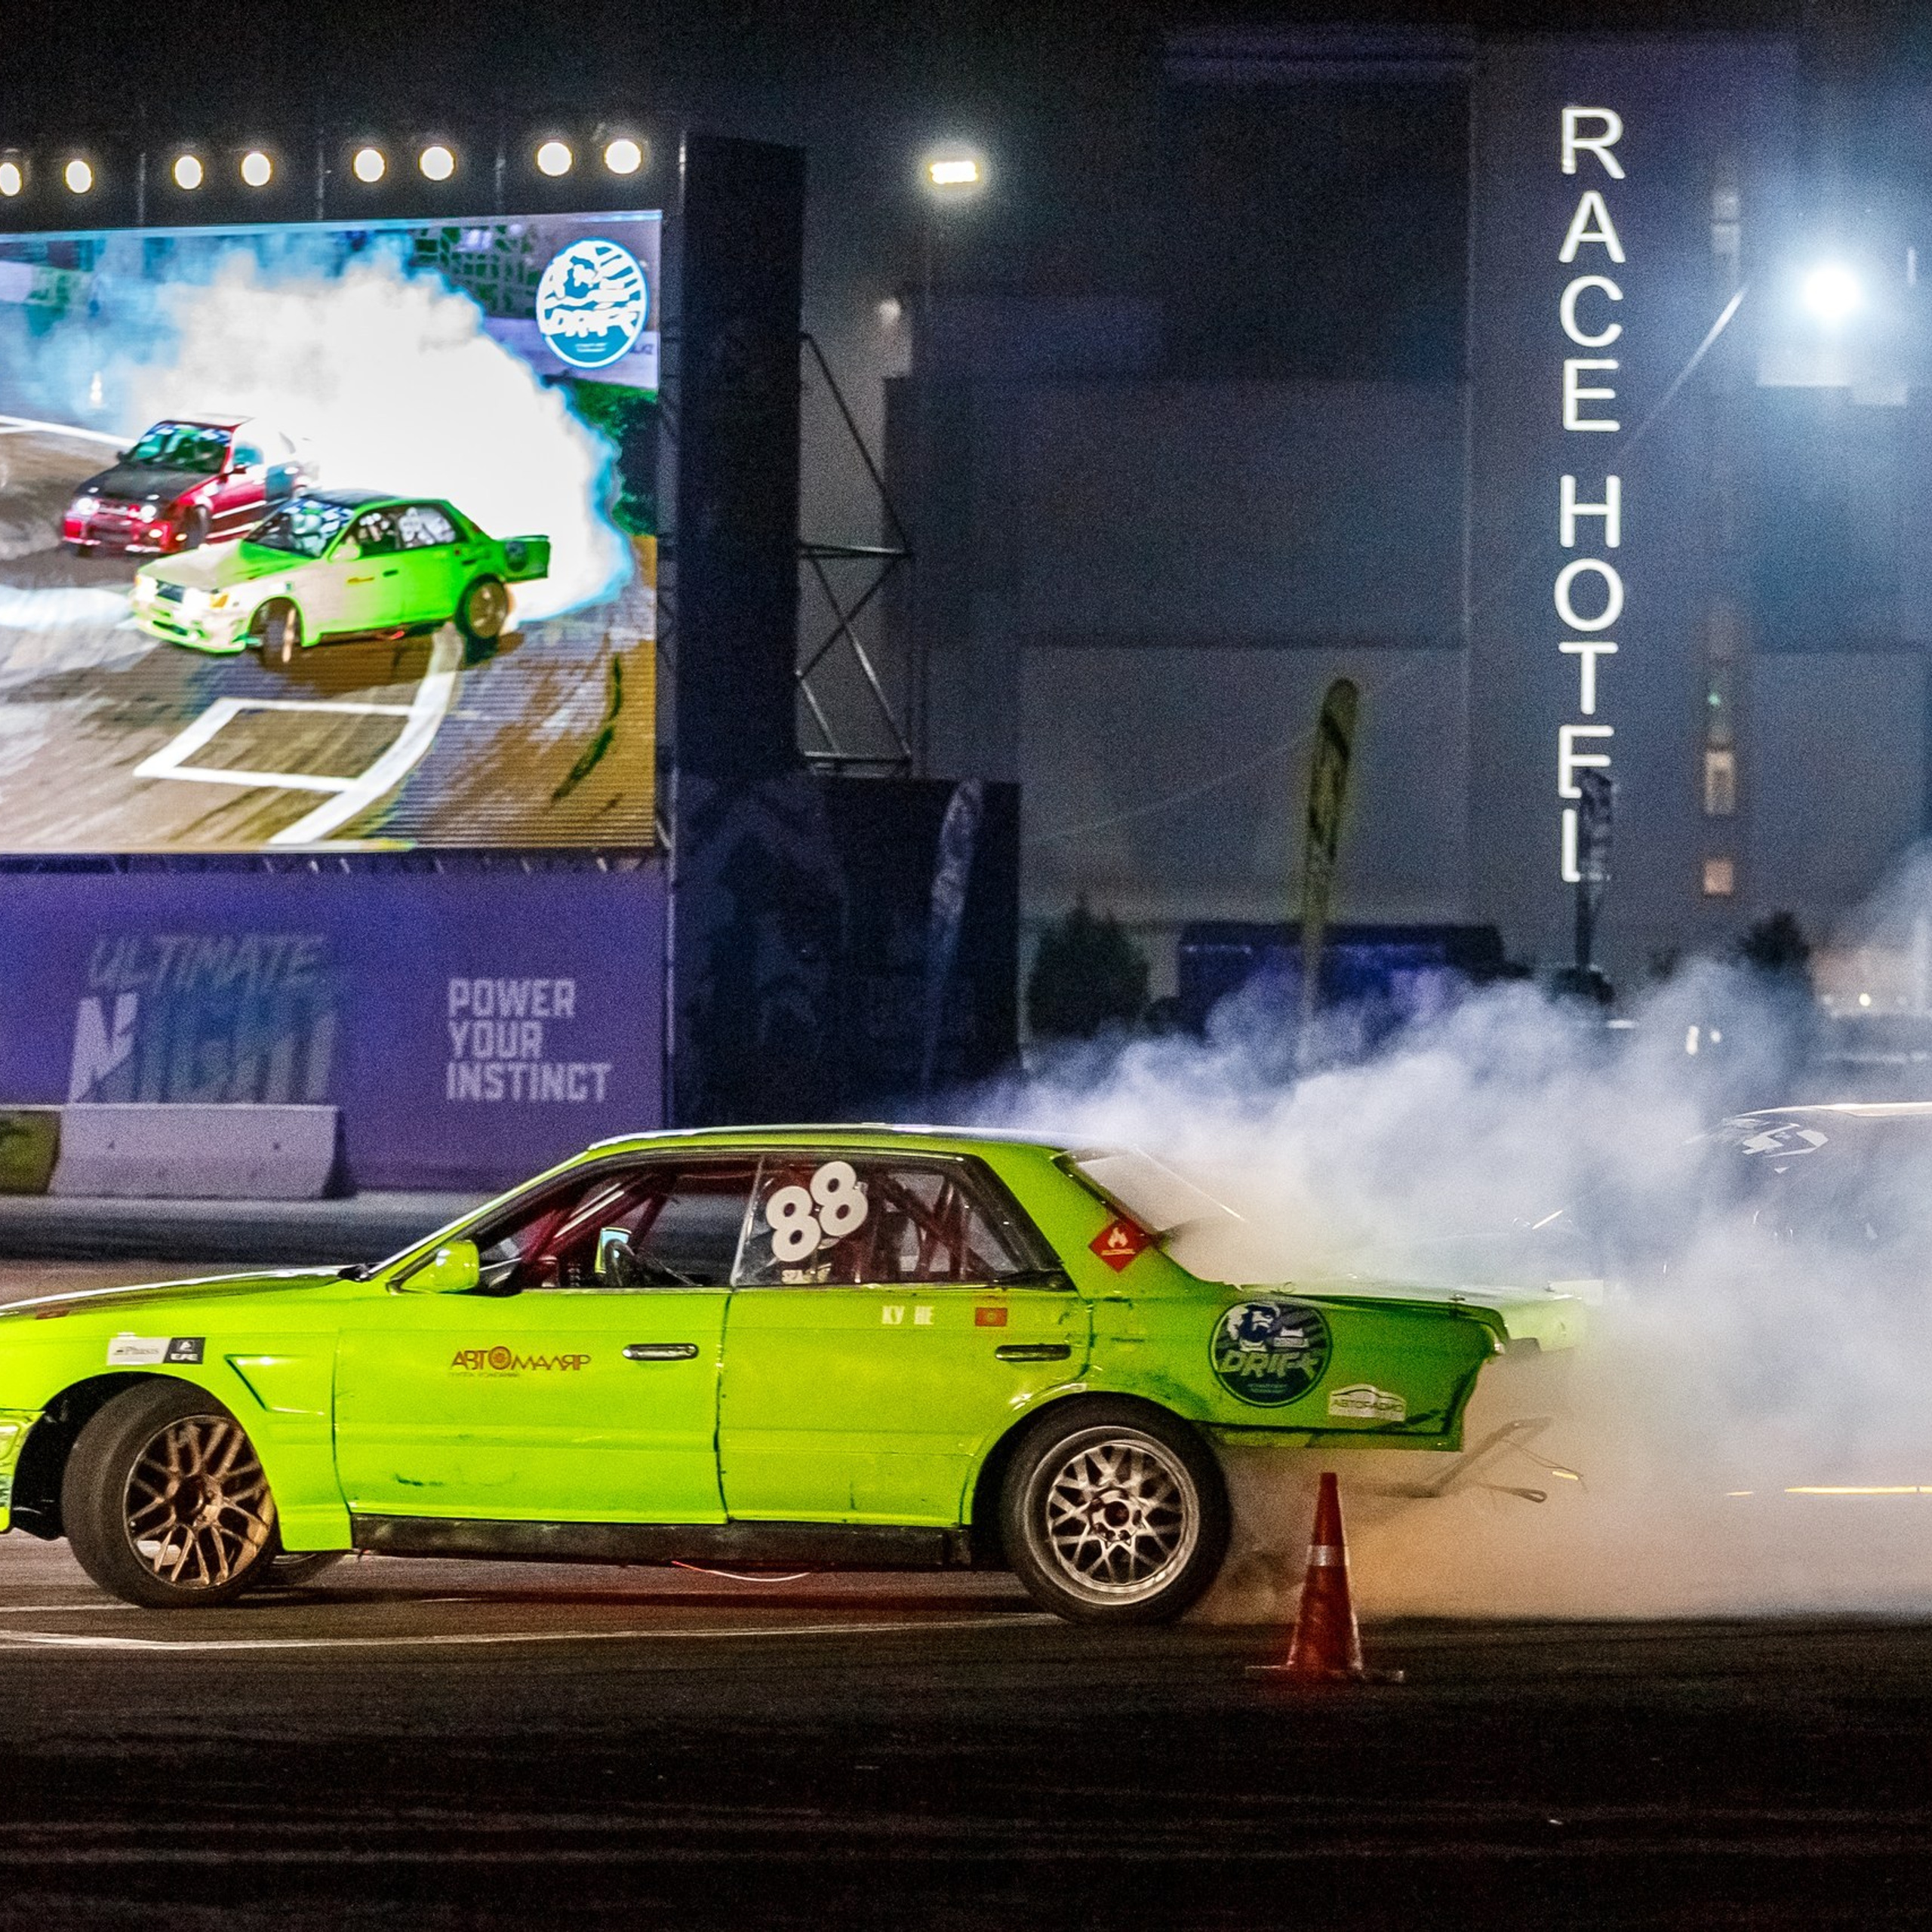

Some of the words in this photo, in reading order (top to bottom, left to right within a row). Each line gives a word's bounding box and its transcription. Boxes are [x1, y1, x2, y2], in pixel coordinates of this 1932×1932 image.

[1558, 106, 1626, 432] RACE
[87, 934, 325, 992] ULTIMATE
[448, 977, 576, 1018] POWER
[448, 1020, 543, 1059] YOUR
[446, 1060, 613, 1103] INSTINCT
[765, 1161, 868, 1263] 88
[1217, 1349, 1321, 1381] DRIFT
